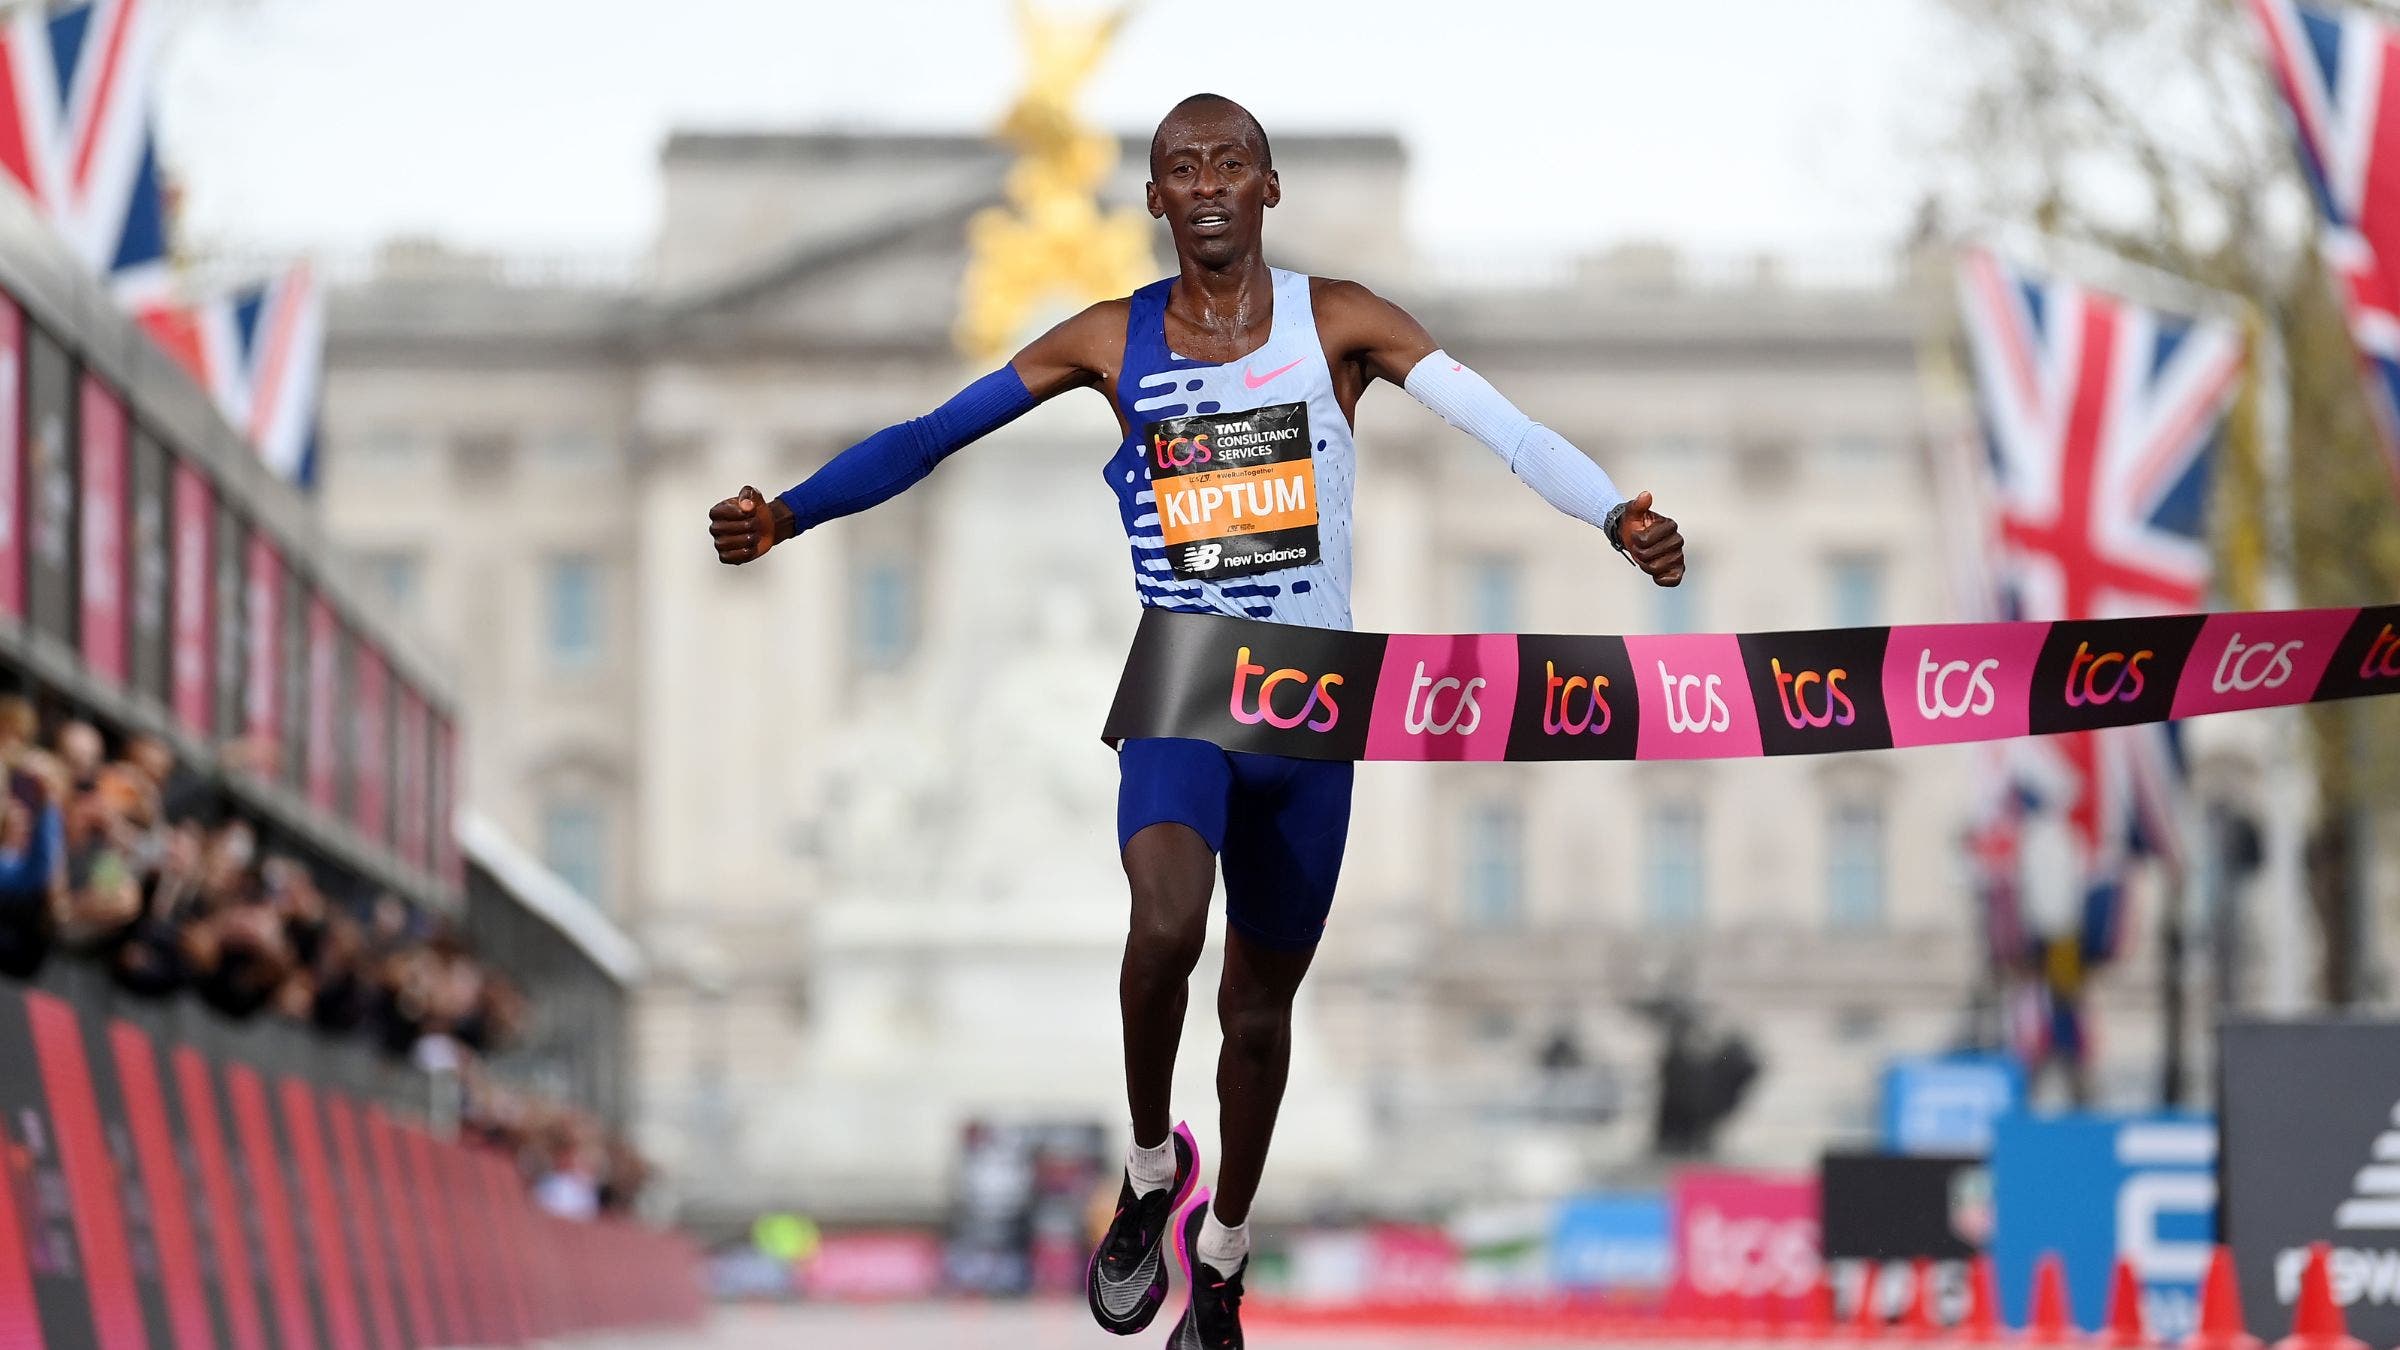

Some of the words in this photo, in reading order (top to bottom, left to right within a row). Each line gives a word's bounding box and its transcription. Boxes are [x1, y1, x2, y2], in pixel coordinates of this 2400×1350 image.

[1215, 420, 1251, 435] TATA
[1217, 427, 1299, 448] CONSULTANCY
[1154, 433, 1212, 469] tcs
[1218, 444, 1272, 461] SERVICES
[1164, 475, 1306, 528] KIPTUM
[1224, 555, 1251, 568] new
[1254, 547, 1307, 564] balance
[1229, 646, 1346, 733] tcs
[1404, 661, 1487, 736] tcs
[1544, 660, 1611, 736] tcs
[1657, 660, 1731, 735] tcs
[1772, 658, 1855, 729] tcs
[1916, 648, 1999, 719] tcs
[2065, 641, 2154, 707] tcs
[2212, 633, 2304, 694] tcs
